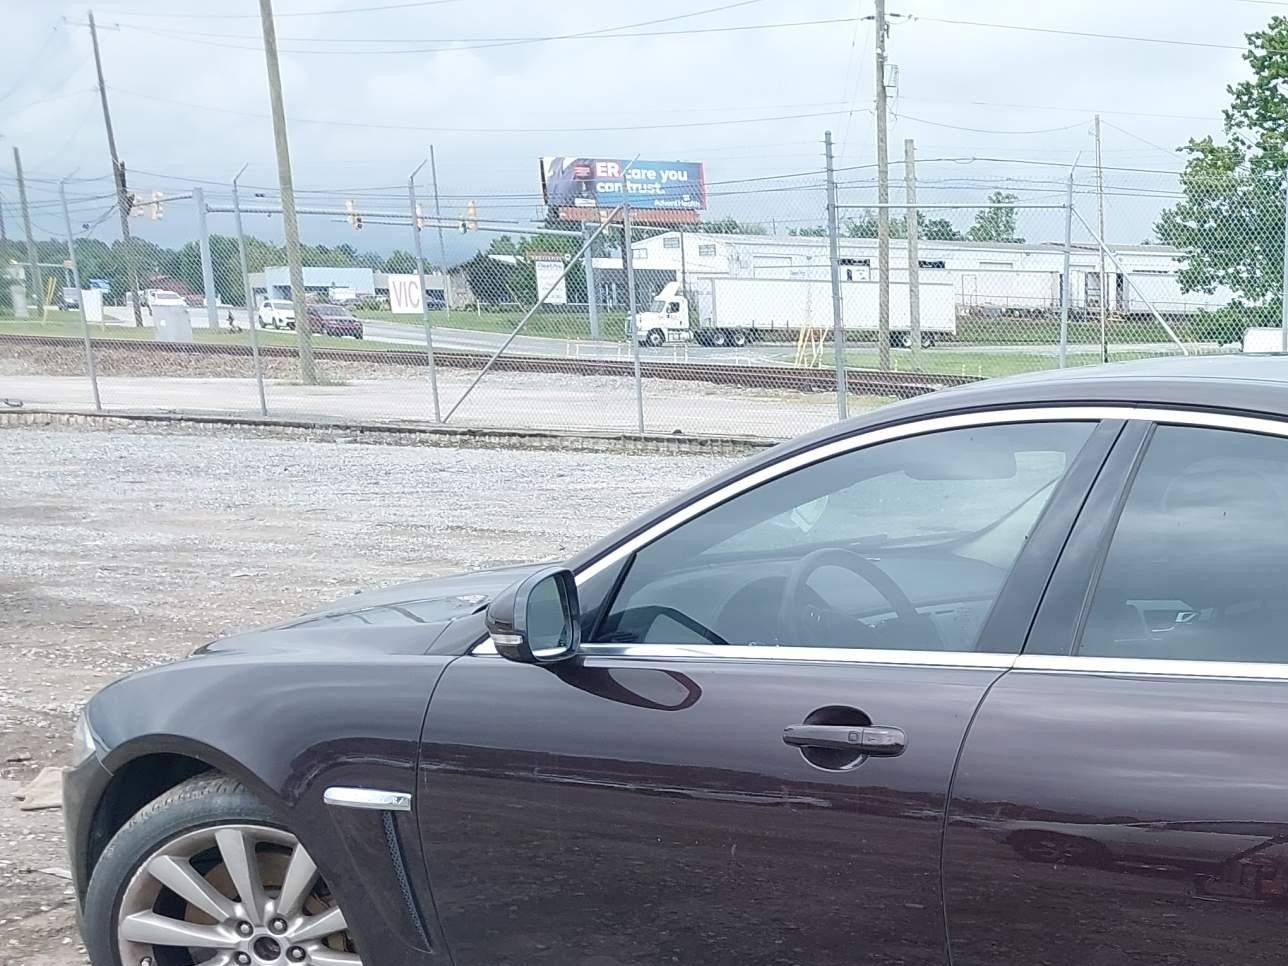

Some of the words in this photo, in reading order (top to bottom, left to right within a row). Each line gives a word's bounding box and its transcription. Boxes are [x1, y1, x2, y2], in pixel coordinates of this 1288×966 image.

[596, 162, 619, 177] ER
[625, 168, 657, 180] care
[659, 170, 687, 184] you
[596, 182, 623, 192] can
[626, 181, 665, 194] trust.
[392, 280, 420, 308] VIC
